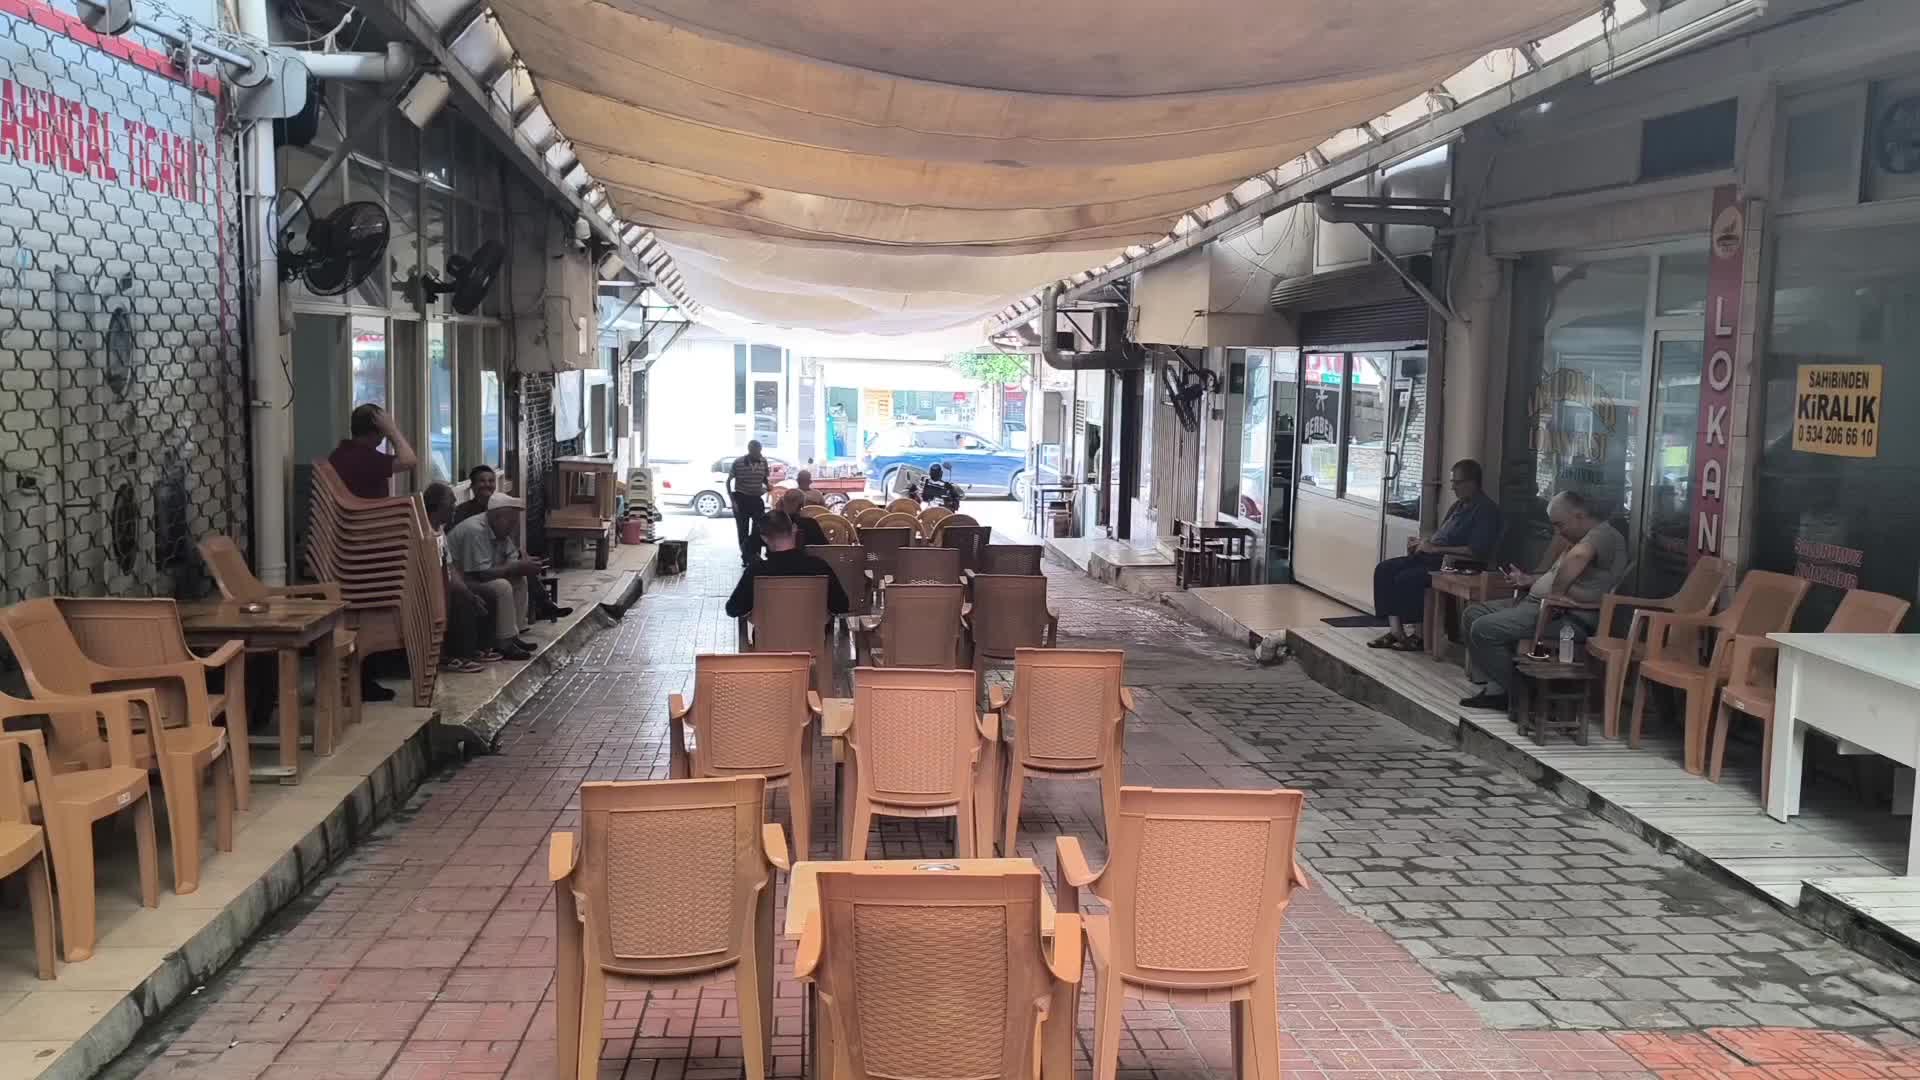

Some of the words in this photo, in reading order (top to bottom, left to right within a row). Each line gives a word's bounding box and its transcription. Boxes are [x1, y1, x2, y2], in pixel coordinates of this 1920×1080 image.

[1798, 393, 1877, 424] KiRALIK
[1697, 296, 1733, 554] LOKAN
[1798, 424, 1804, 442] 0
[1806, 425, 1823, 443] 534
[1825, 426, 1843, 445] 206
[1846, 427, 1858, 445] 66
[1862, 428, 1873, 447] 10
